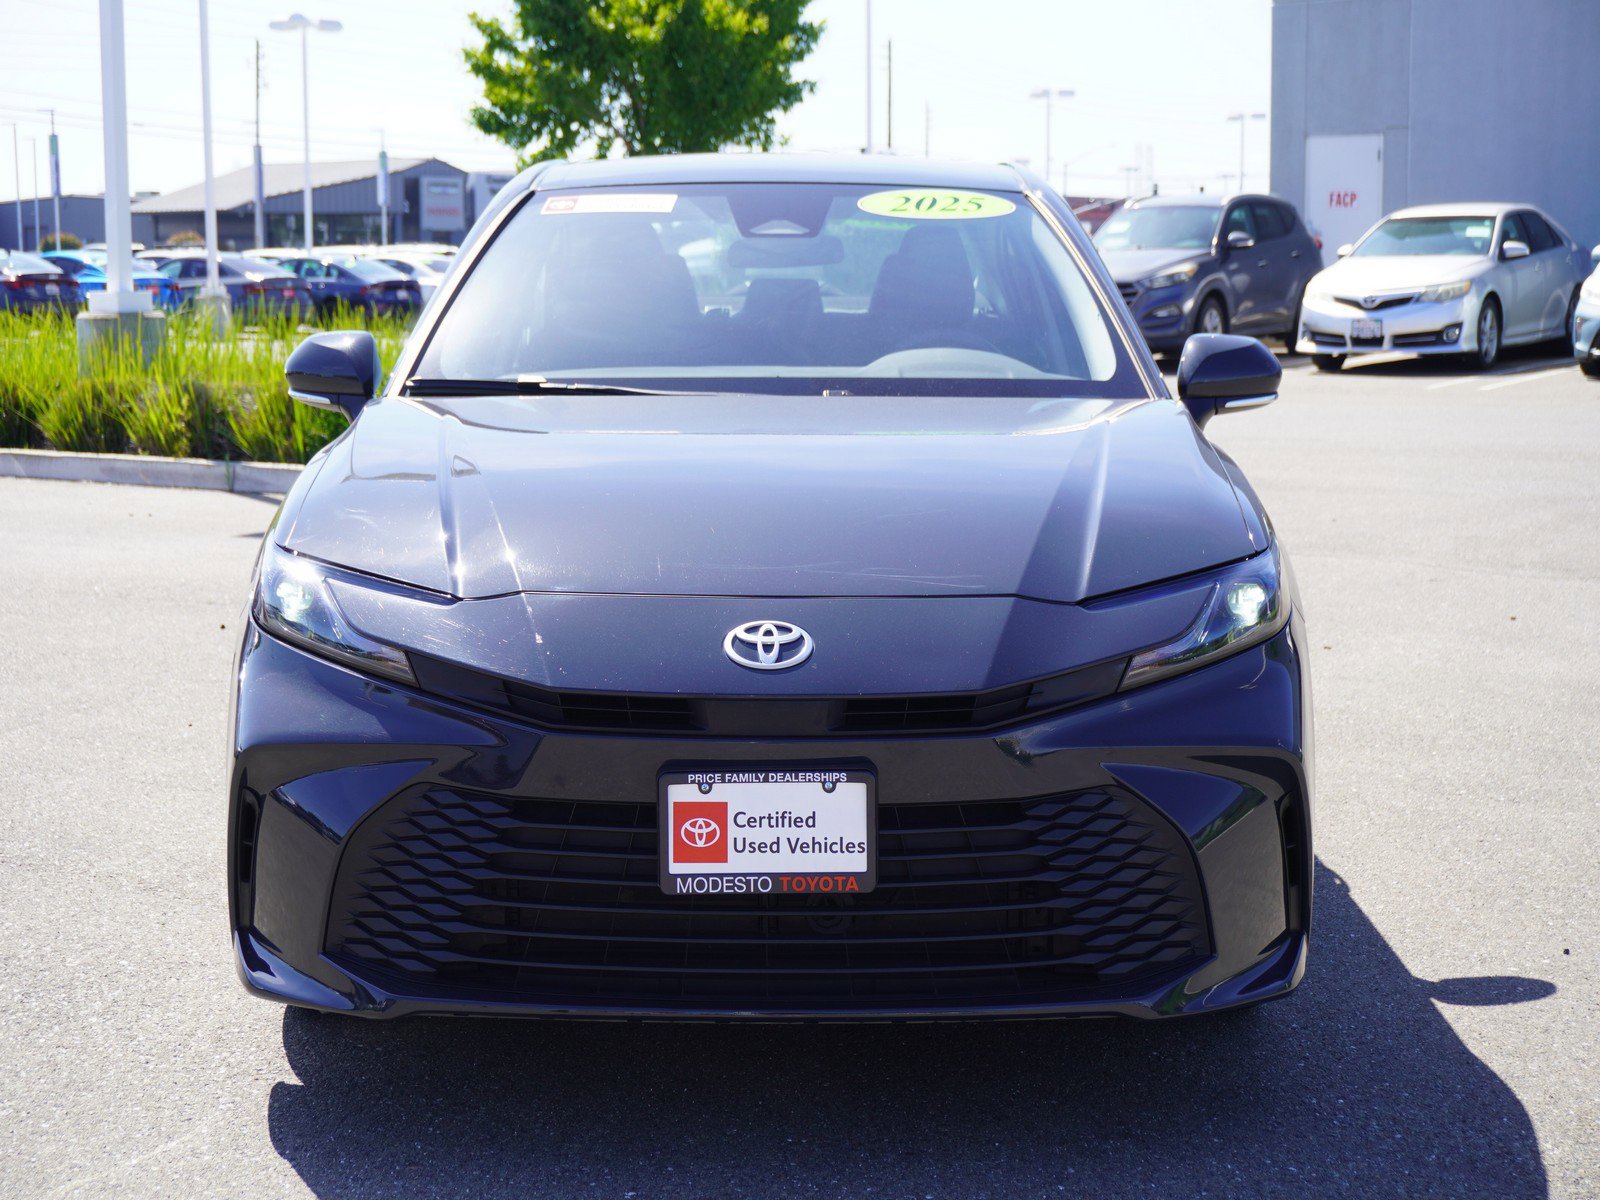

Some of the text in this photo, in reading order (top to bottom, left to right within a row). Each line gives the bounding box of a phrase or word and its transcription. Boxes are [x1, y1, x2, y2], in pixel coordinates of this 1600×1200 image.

[890, 196, 985, 212] 2025
[1329, 192, 1357, 208] FACP
[687, 773, 848, 783] PRICE FAMILY DEALERSHIPS
[733, 811, 816, 828] Certified
[733, 837, 866, 854] Used Vehicles
[676, 876, 859, 893] MODESTO TOYOTA
